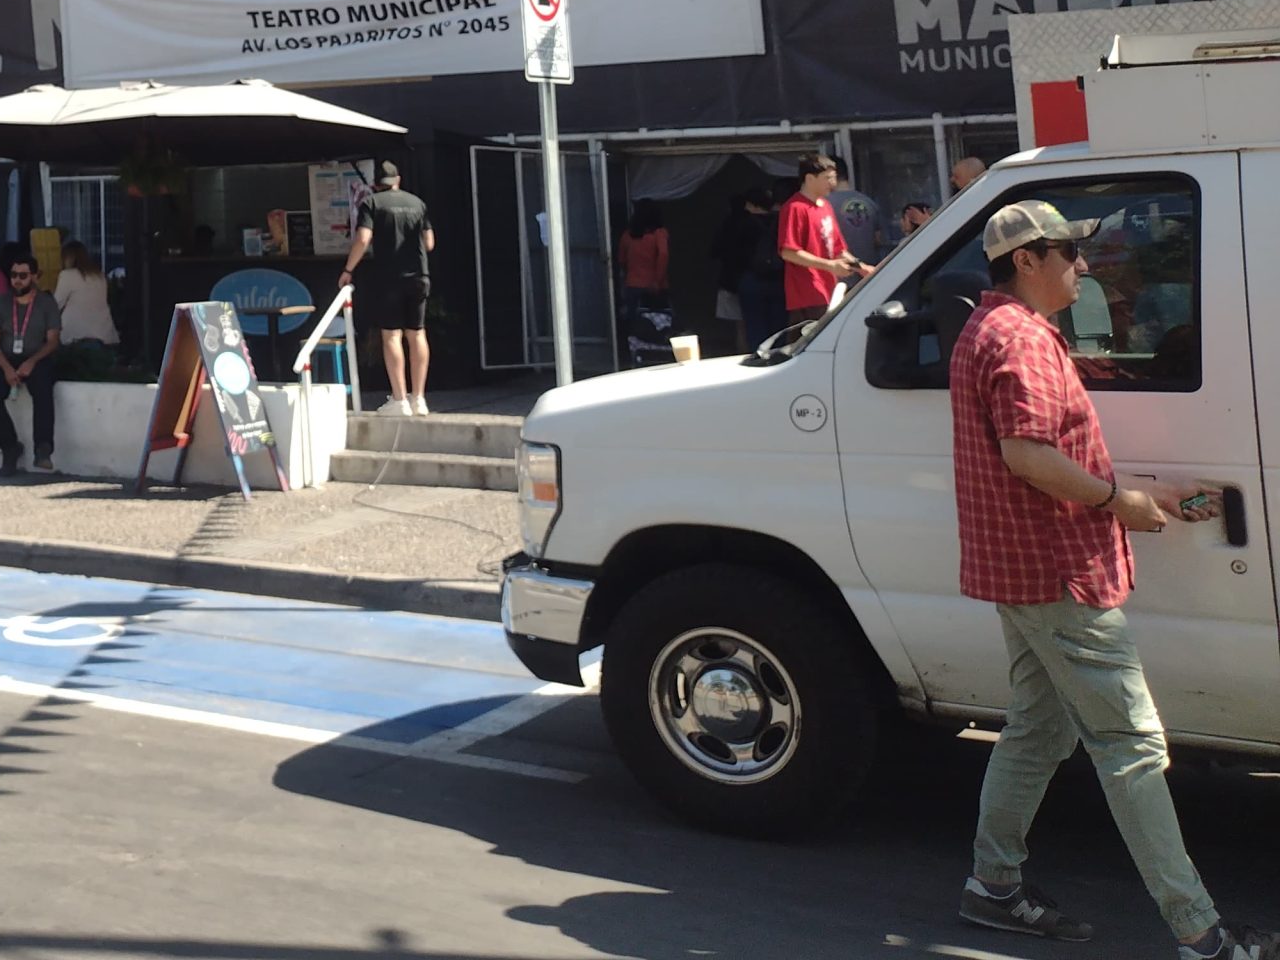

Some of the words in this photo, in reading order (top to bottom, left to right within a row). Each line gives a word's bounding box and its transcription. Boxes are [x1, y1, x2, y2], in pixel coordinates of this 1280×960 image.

[246, 6, 341, 29] TEATRO
[241, 38, 272, 54] AV.
[275, 36, 313, 52] LOS
[317, 25, 424, 49] PAJARITOS
[457, 14, 511, 35] 2045
